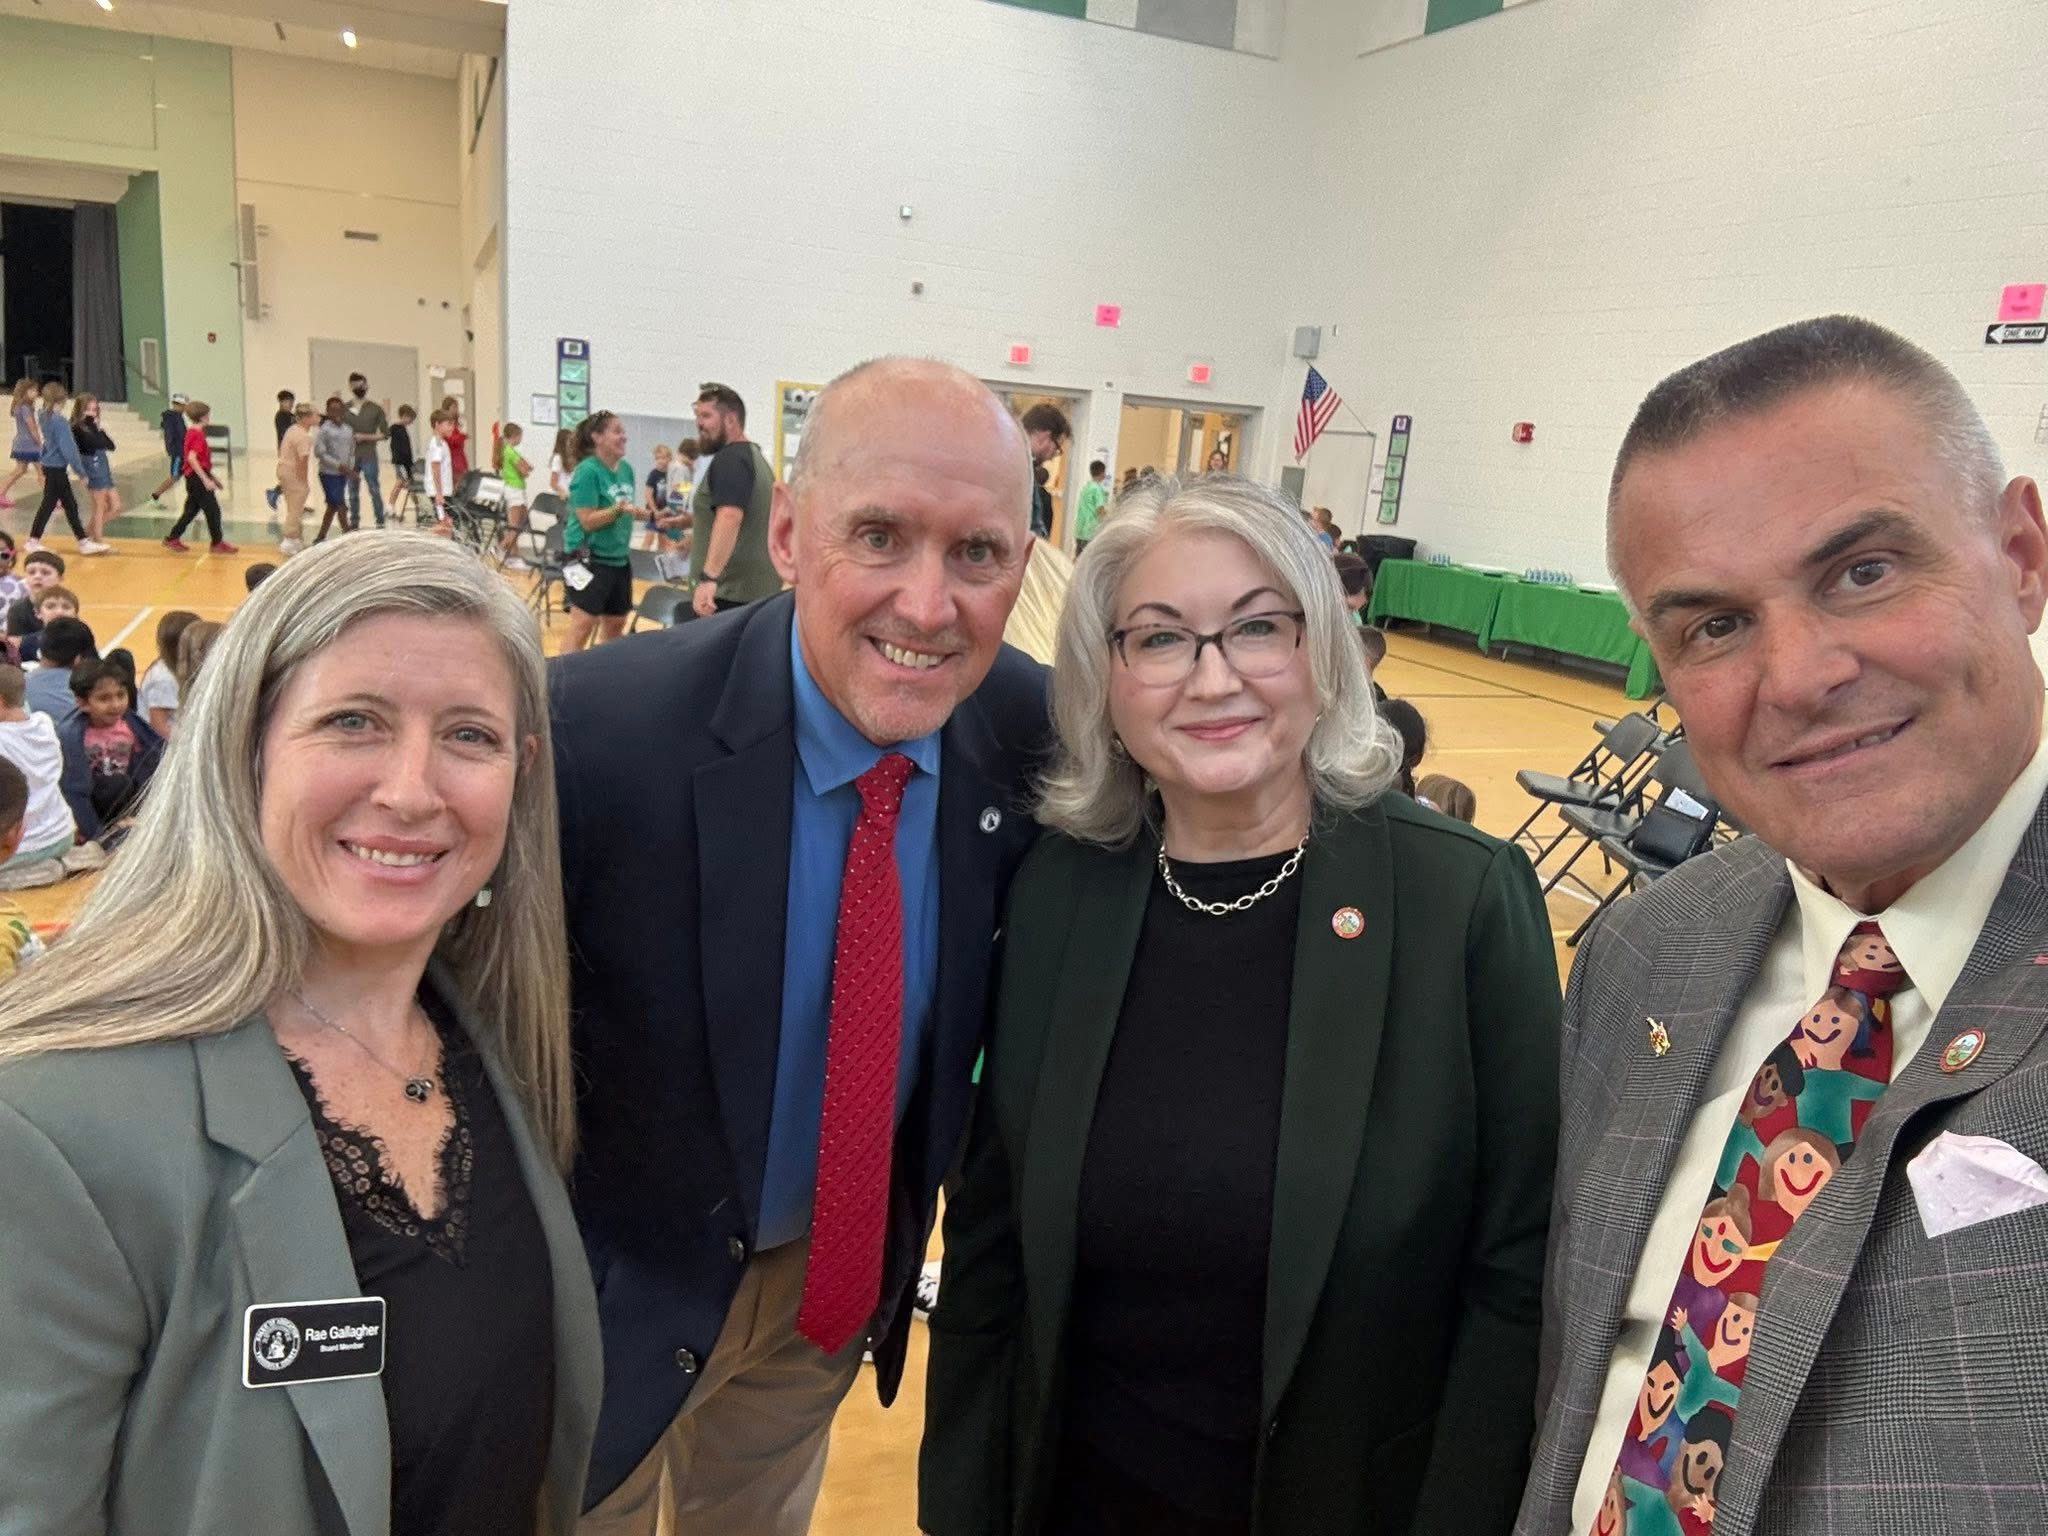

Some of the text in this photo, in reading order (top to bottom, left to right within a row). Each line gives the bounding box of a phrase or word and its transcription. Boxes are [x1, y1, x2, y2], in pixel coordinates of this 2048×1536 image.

[2004, 328, 2042, 338] ONE WAY
[305, 1328, 327, 1341] Rae
[329, 1324, 379, 1340] Gallagher
[339, 1343, 364, 1351] Member
